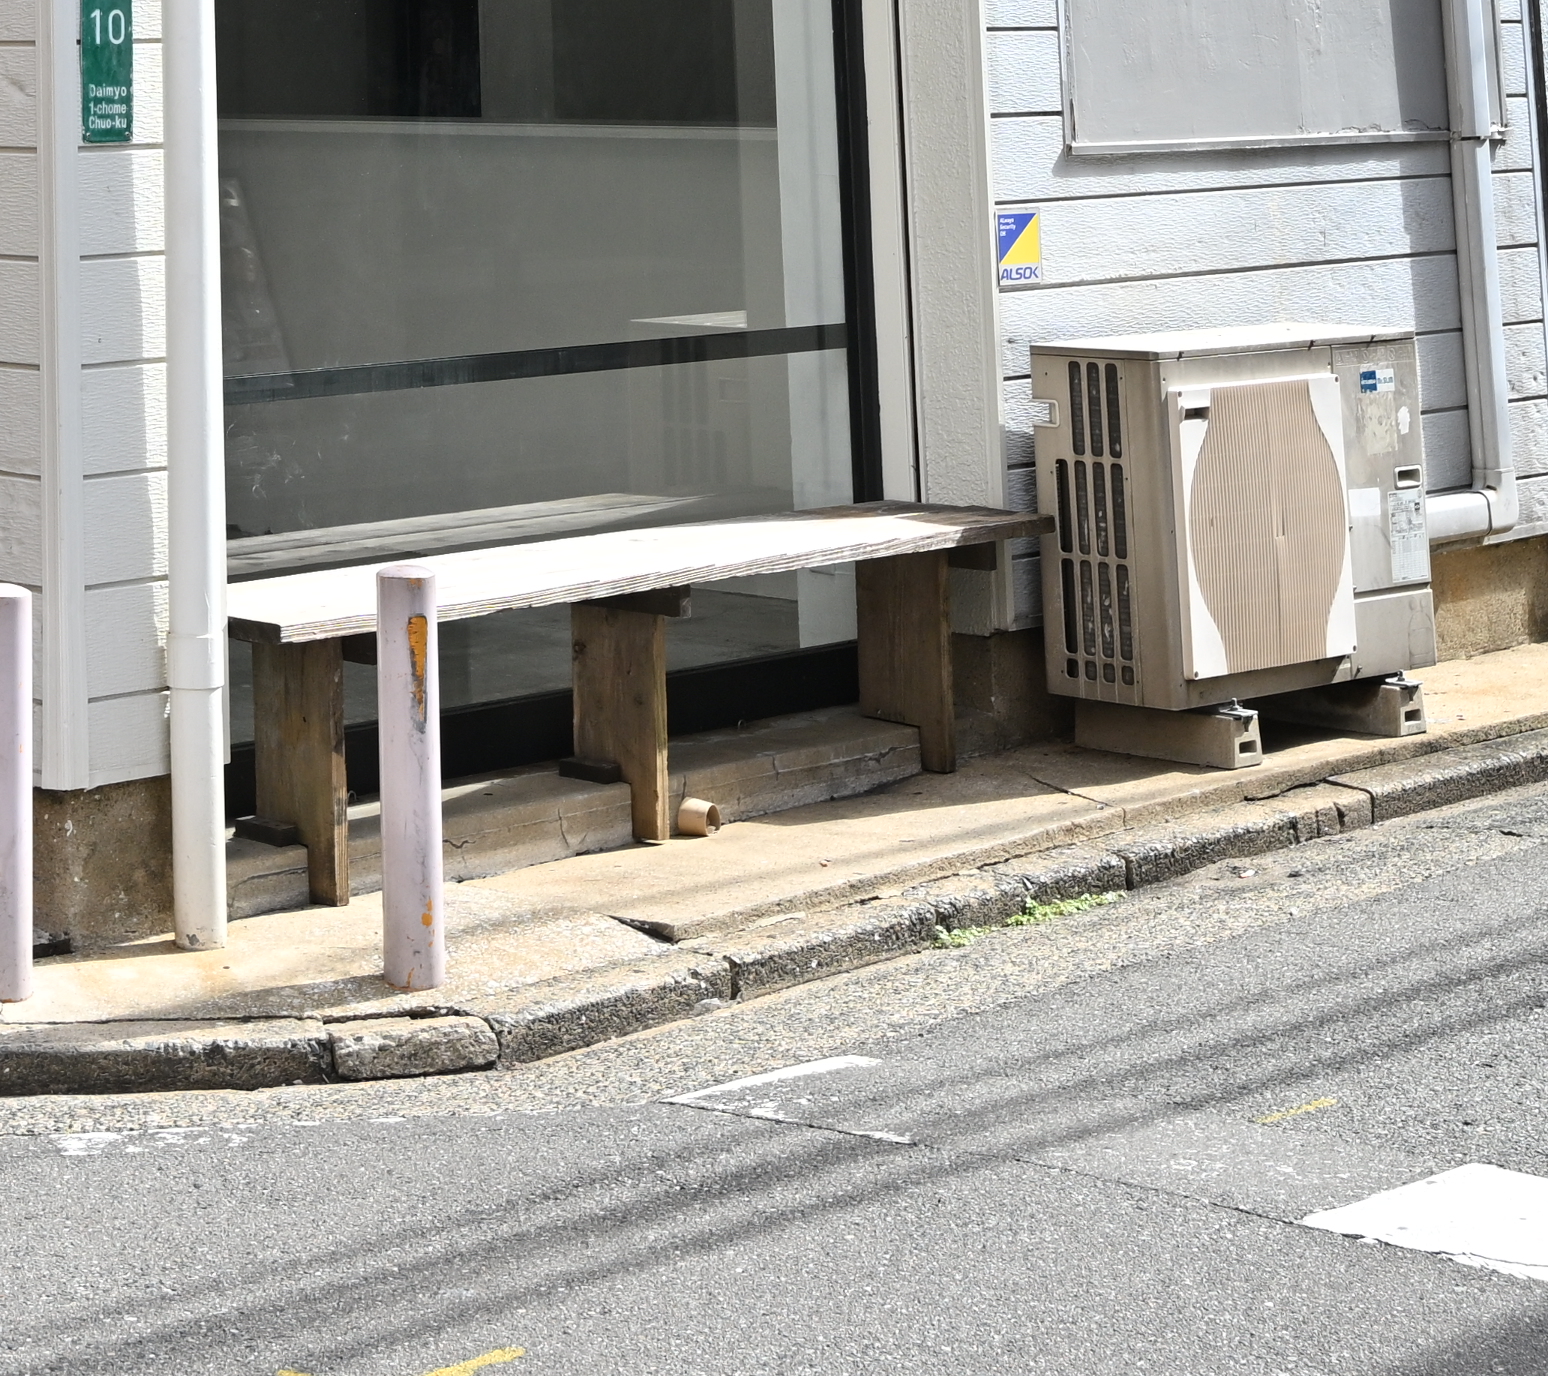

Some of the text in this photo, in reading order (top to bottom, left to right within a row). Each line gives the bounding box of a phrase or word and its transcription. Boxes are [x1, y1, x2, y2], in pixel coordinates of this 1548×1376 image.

[89, 8, 126, 45] 10
[89, 83, 127, 99] Daimyo
[88, 101, 127, 114] 1-chome
[88, 115, 127, 129] Chuo-ku
[1000, 265, 1039, 281] ALSOK
